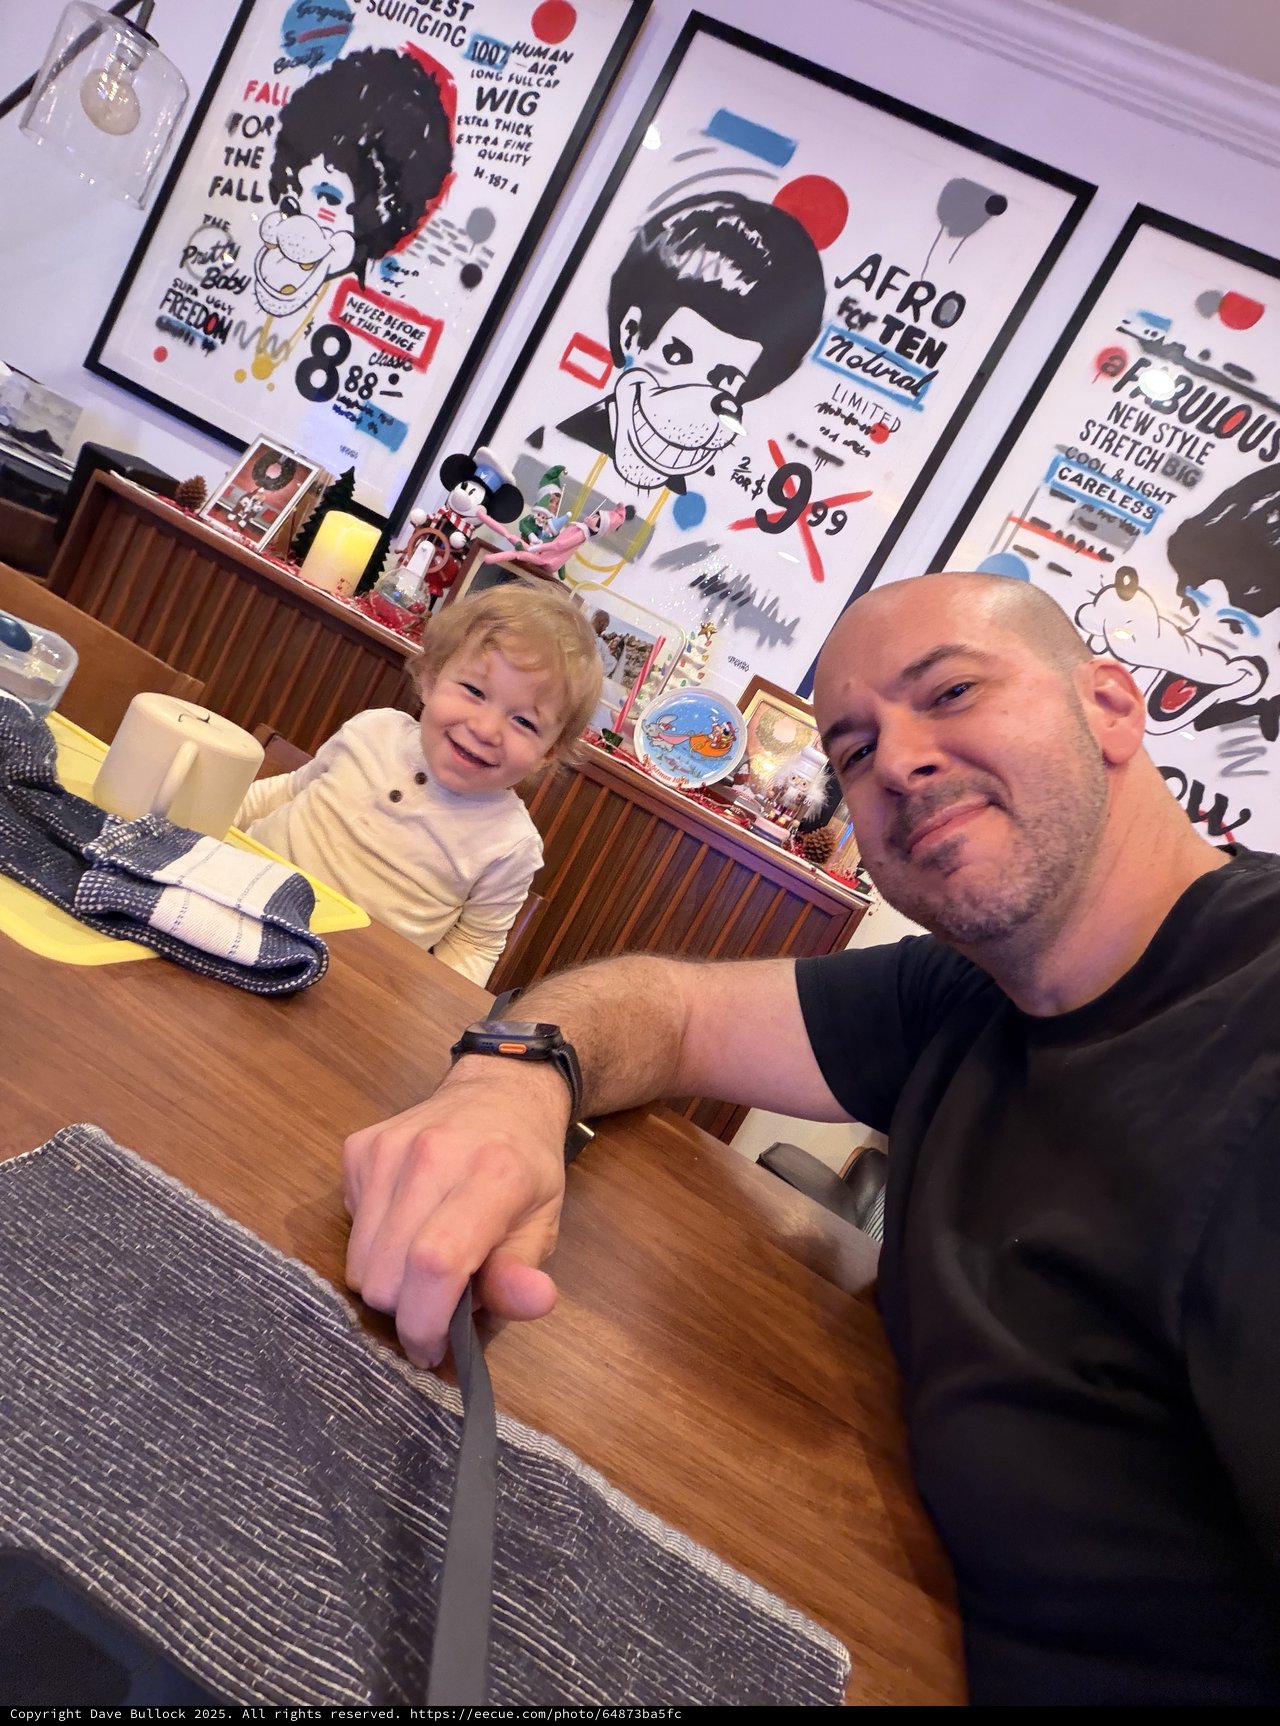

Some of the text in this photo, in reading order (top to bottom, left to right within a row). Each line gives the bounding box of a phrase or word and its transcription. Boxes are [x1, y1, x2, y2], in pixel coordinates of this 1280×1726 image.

[511, 40, 574, 64] HUMAN
[470, 69, 560, 89] LONG FULL CAP
[243, 80, 290, 107] FALL
[475, 86, 540, 116] WIG
[227, 112, 275, 138] FOR
[457, 115, 534, 138] EXTRA THICK
[456, 134, 533, 152] EXTRA FINE
[224, 146, 264, 169] THE
[477, 149, 532, 167] QUALITY
[208, 175, 265, 203] FALL
[203, 213, 231, 232] THE
[172, 278, 199, 297] SUPA
[200, 266, 252, 294] Baby
[834, 253, 966, 329] AFRO
[339, 311, 358, 326] AT
[357, 317, 384, 335] THIS
[383, 314, 426, 341] BEFORE
[879, 314, 948, 369] TEN
[830, 383, 901, 433] LIMITED
[1112, 356, 1280, 462] FBULOUS
[1107, 400, 1216, 466] NEW STYLE
[1079, 418, 1202, 489] STRETCH BIG
[730, 472, 754, 493] FOR
[1064, 445, 1178, 505] COOL & LIGHT
[1057, 466, 1158, 520] CARELESS
